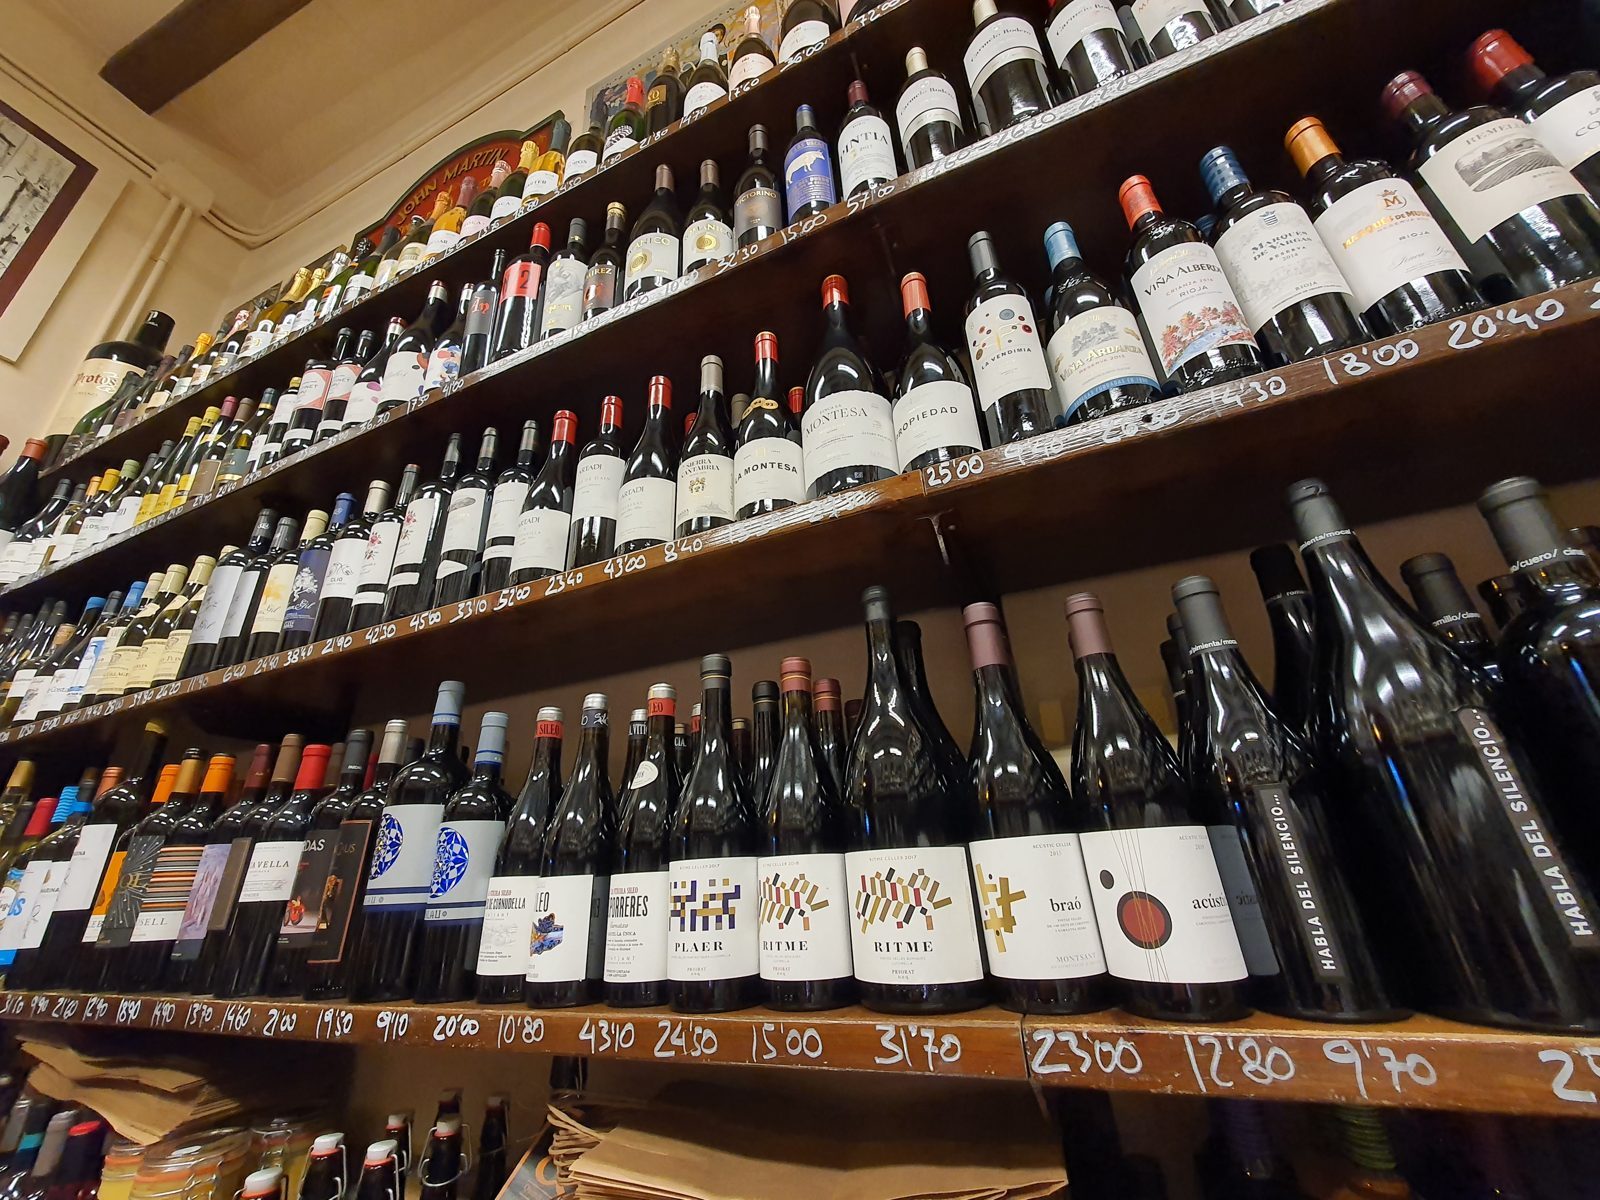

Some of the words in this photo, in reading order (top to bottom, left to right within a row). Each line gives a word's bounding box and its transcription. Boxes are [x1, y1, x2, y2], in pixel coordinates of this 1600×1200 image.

[397, 178, 438, 226] JOHN
[443, 148, 510, 184] MARTIN
[1383, 195, 1402, 208] M
[781, 213, 828, 244] 15'00
[519, 269, 530, 290] 2
[1144, 274, 1175, 296] VIÑA
[1179, 285, 1208, 297] RIOJA
[1448, 298, 1565, 350] 20'40
[991, 347, 1032, 362] VENDIMIA
[1323, 341, 1419, 385] 18'00
[743, 461, 799, 477] MONTESA
[926, 454, 985, 488] 25'00
[664, 538, 703, 563] 8'40
[603, 553, 647, 580] 43'00
[544, 572, 583, 597] 23'40
[539, 724, 560, 735] SILEO
[1521, 819, 1552, 858] DEL
[1050, 895, 1082, 912] braó
[1296, 881, 1316, 910] DEL
[1544, 865, 1594, 936] HABLA
[674, 941, 723, 952] PLAER
[763, 940, 808, 952] RITME
[874, 941, 934, 953] RITME
[1307, 916, 1336, 970] HABLA
[433, 1014, 479, 1040] 20'00
[497, 1014, 544, 1048] 10'80
[579, 1017, 634, 1054] 43'10
[654, 1020, 718, 1057] 24'50
[752, 1022, 823, 1062] 15'00
[874, 1025, 961, 1071] 31'70
[1032, 1029, 1142, 1073] 23'00
[1184, 1035, 1295, 1092] 12'80
[1323, 1040, 1437, 1099] 9'70
